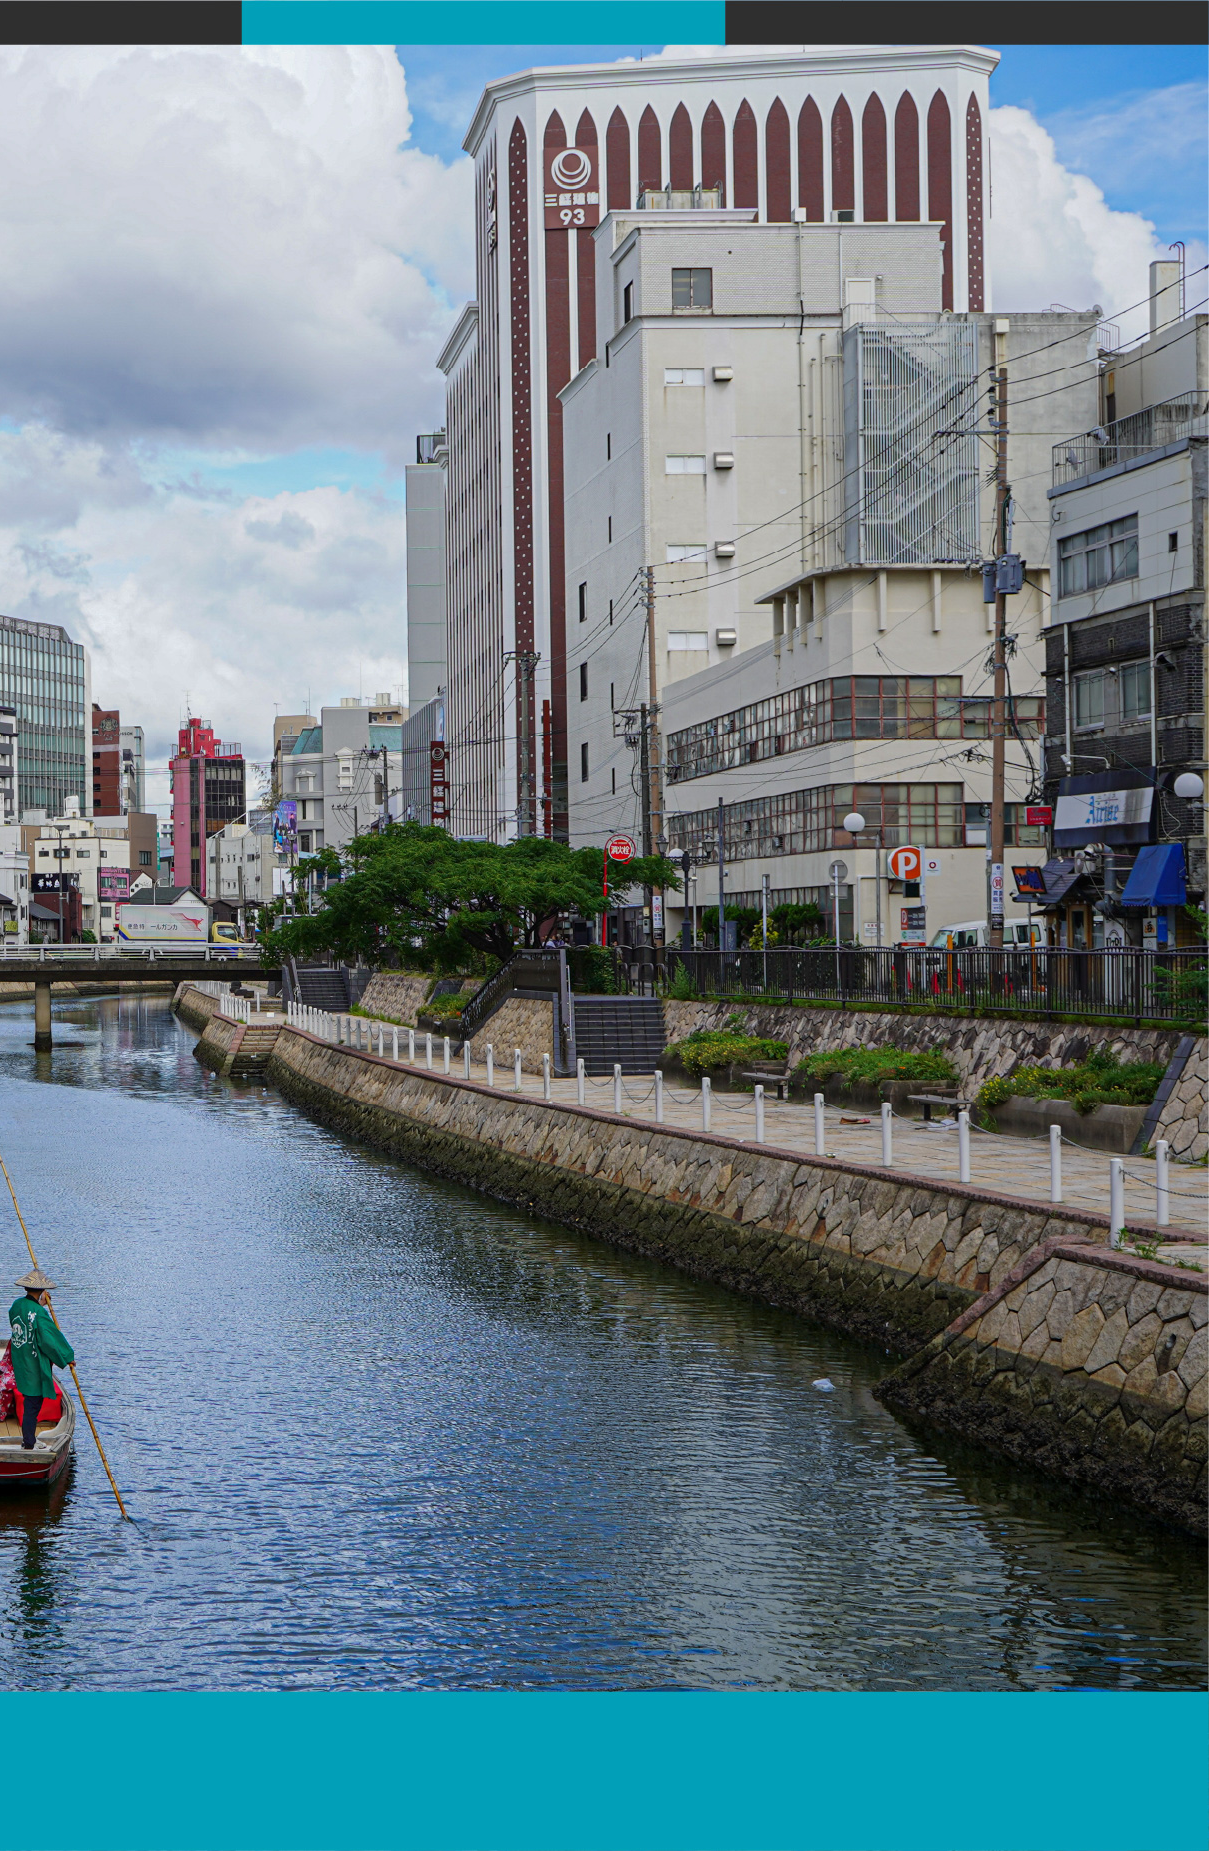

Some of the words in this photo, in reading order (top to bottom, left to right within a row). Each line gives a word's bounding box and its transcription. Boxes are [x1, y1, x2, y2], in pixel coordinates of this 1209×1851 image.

[559, 208, 586, 226] 93
[611, 845, 630, 855] 消火栓
[897, 851, 918, 880] P
